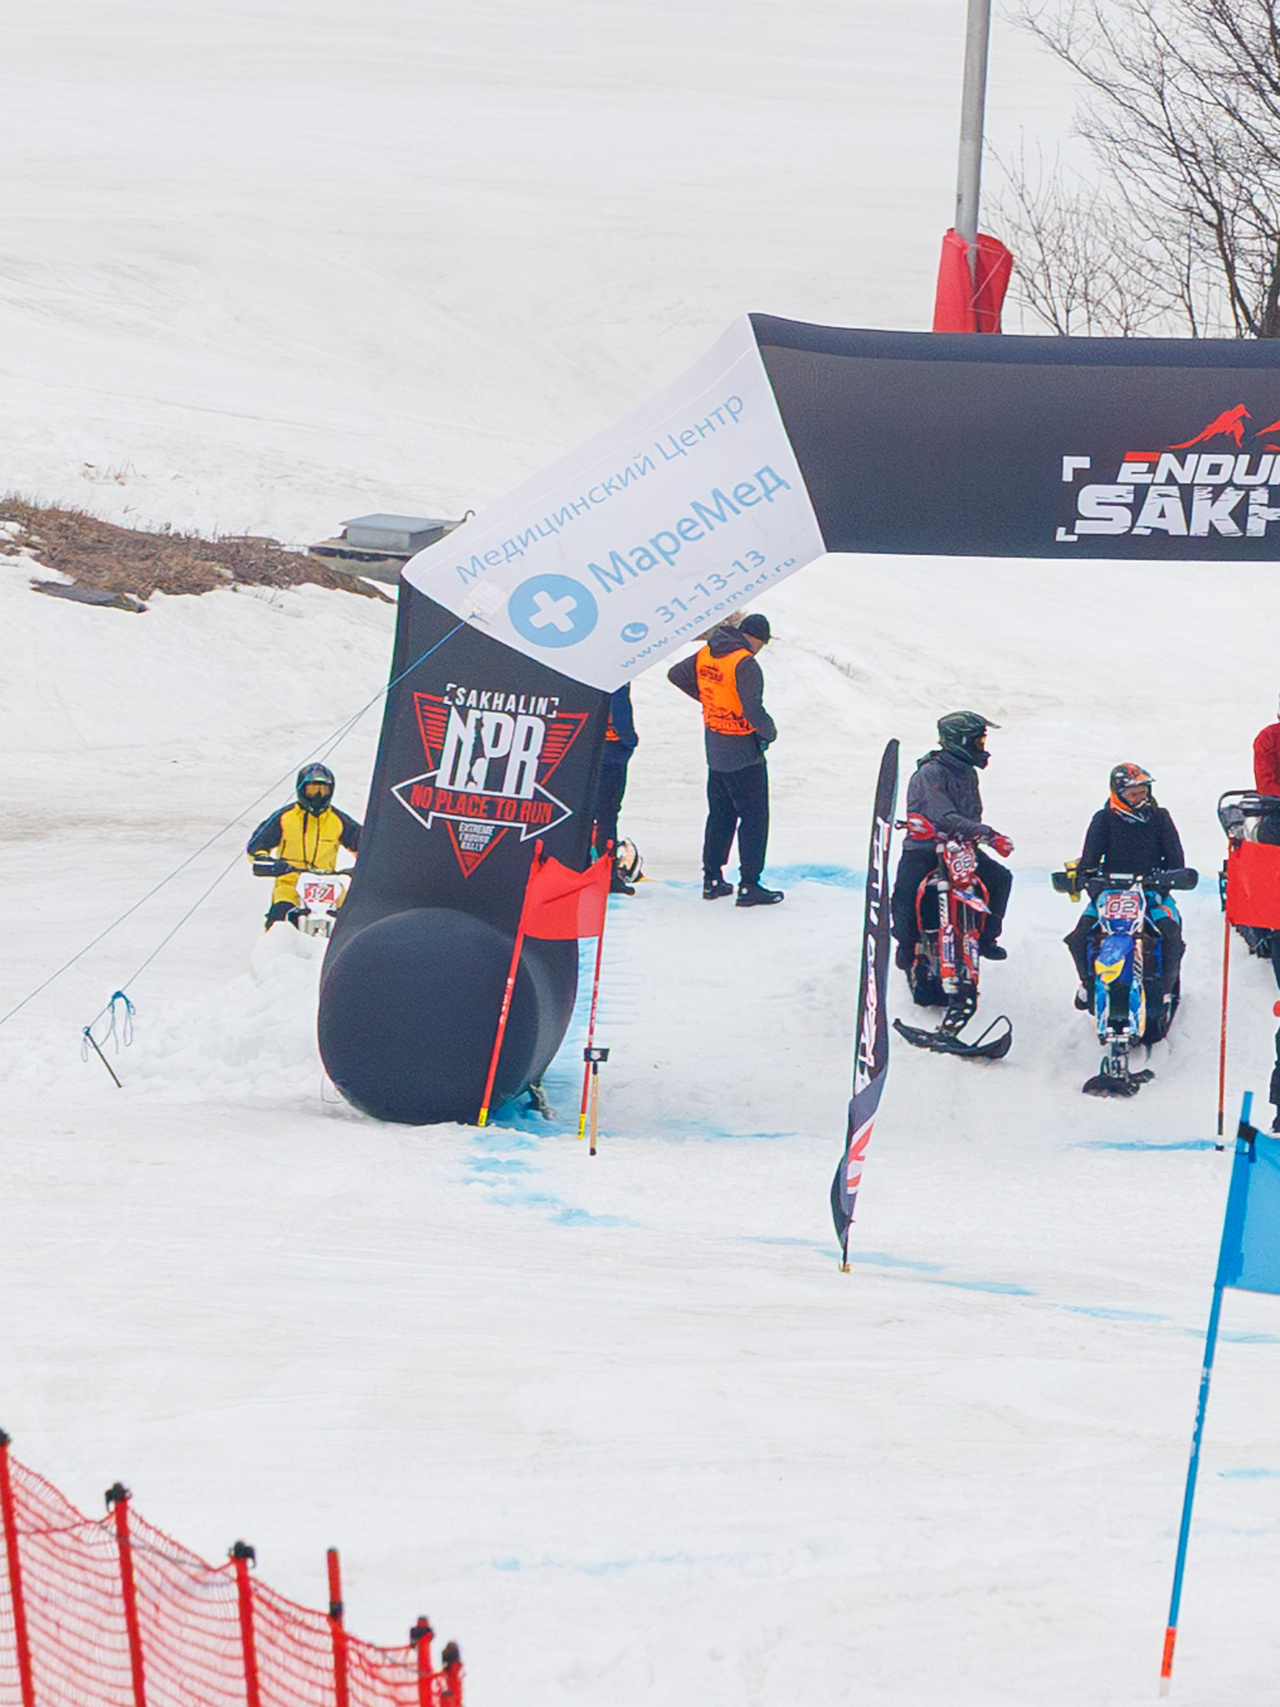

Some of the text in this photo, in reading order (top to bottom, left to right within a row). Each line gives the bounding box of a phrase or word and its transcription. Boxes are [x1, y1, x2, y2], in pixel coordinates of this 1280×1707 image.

[456, 394, 745, 585] Медицинский Центр
[587, 464, 791, 594] МареМед
[619, 557, 796, 669] www.maremed.ru
[655, 549, 767, 624] 31-13-13
[455, 687, 549, 716] SAKHALIN
[435, 706, 546, 799] NPR
[410, 785, 554, 824] NO PLACE TO RUN
[1108, 899, 1136, 915] 02
